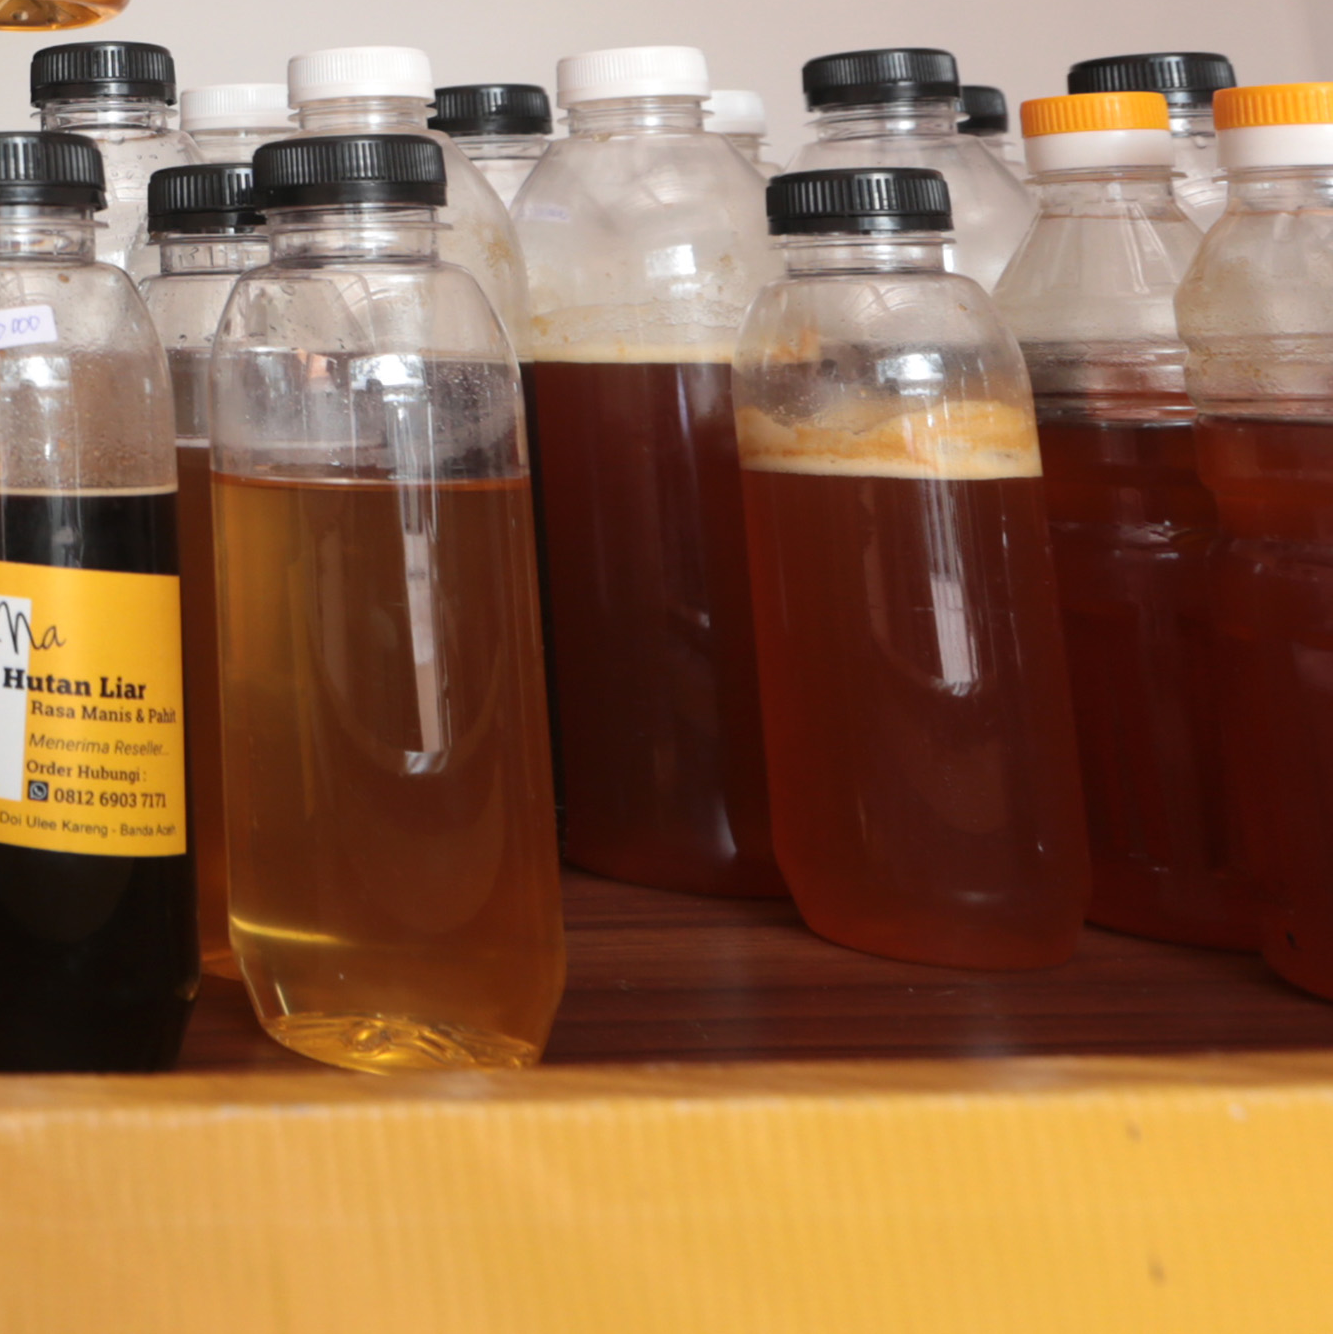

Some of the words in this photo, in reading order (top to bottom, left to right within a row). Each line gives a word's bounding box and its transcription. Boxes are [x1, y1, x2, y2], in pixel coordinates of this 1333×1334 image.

[2, 667, 92, 697] Hutan
[99, 676, 147, 700] Liar
[30, 700, 76, 719] Rasa
[81, 705, 133, 723] Manis
[136, 708, 145, 723] &
[148, 708, 177, 724] Pahit
[28, 733, 111, 754] Menerima
[26, 759, 73, 777] Order
[77, 765, 140, 785] Hubungi
[53, 787, 95, 806] 0812
[99, 791, 138, 808] 6903
[141, 792, 167, 809] 7171
[0, 811, 22, 826] Doi
[26, 816, 57, 831] Ulee
[61, 820, 108, 838] Kareng
[120, 824, 155, 837] Banda
